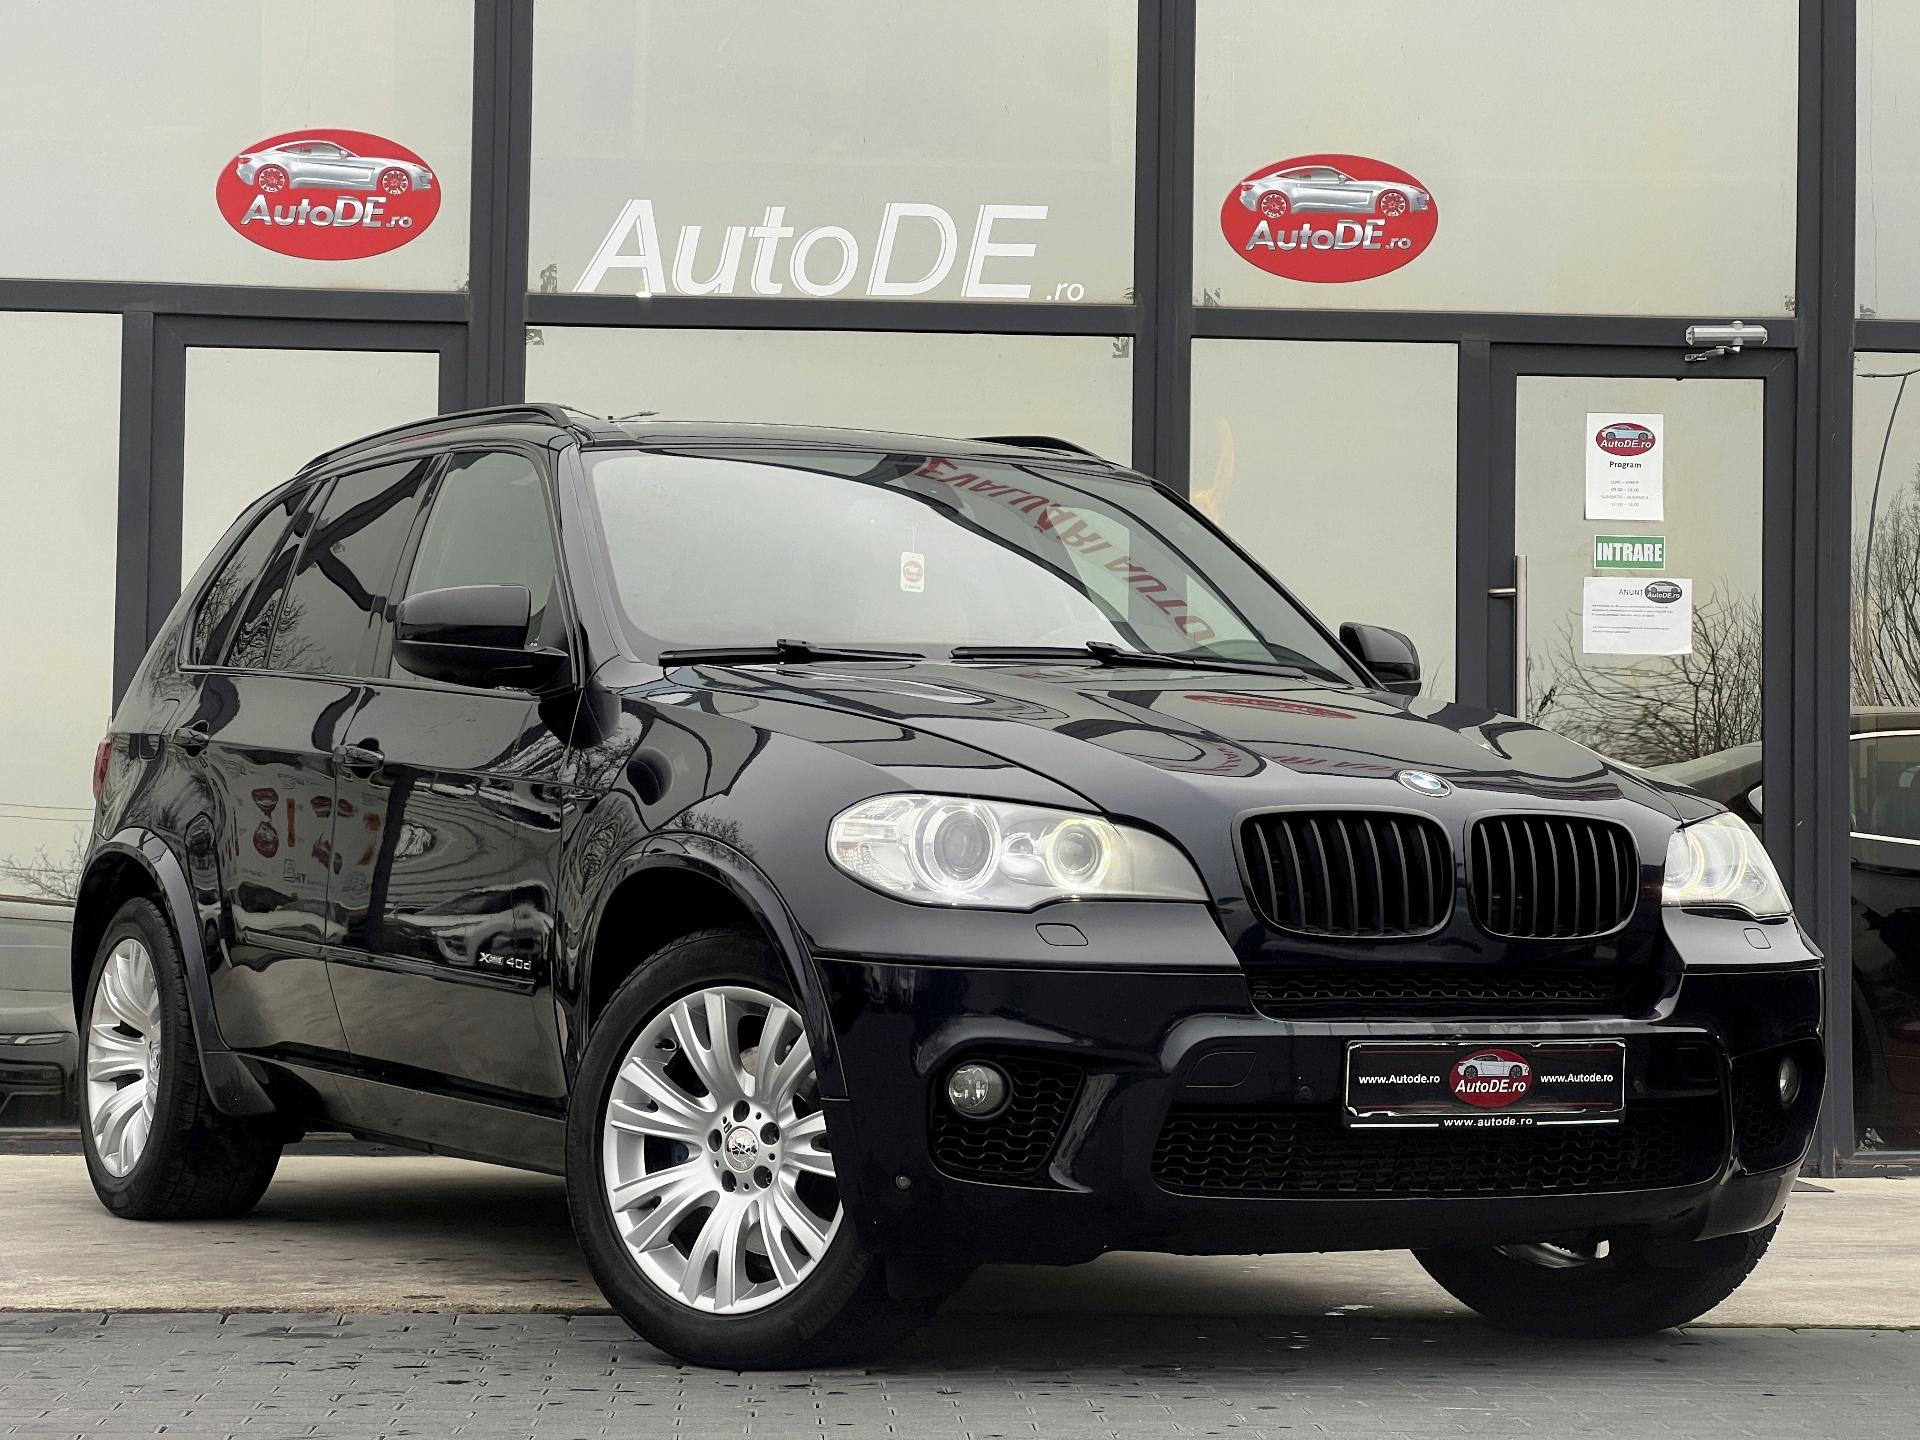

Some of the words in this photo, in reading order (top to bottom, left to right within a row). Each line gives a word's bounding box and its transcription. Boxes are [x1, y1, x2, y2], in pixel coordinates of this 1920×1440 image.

[1609, 461, 1642, 469] Program
[1596, 543, 1663, 562] INTRARE
[1358, 1074, 1441, 1084] www.Autode.ro
[1540, 1073, 1614, 1084] www.Autode.ro
[1455, 1080, 1527, 1094] AutoDE.ro
[1443, 1116, 1533, 1127] www.autode.ro
